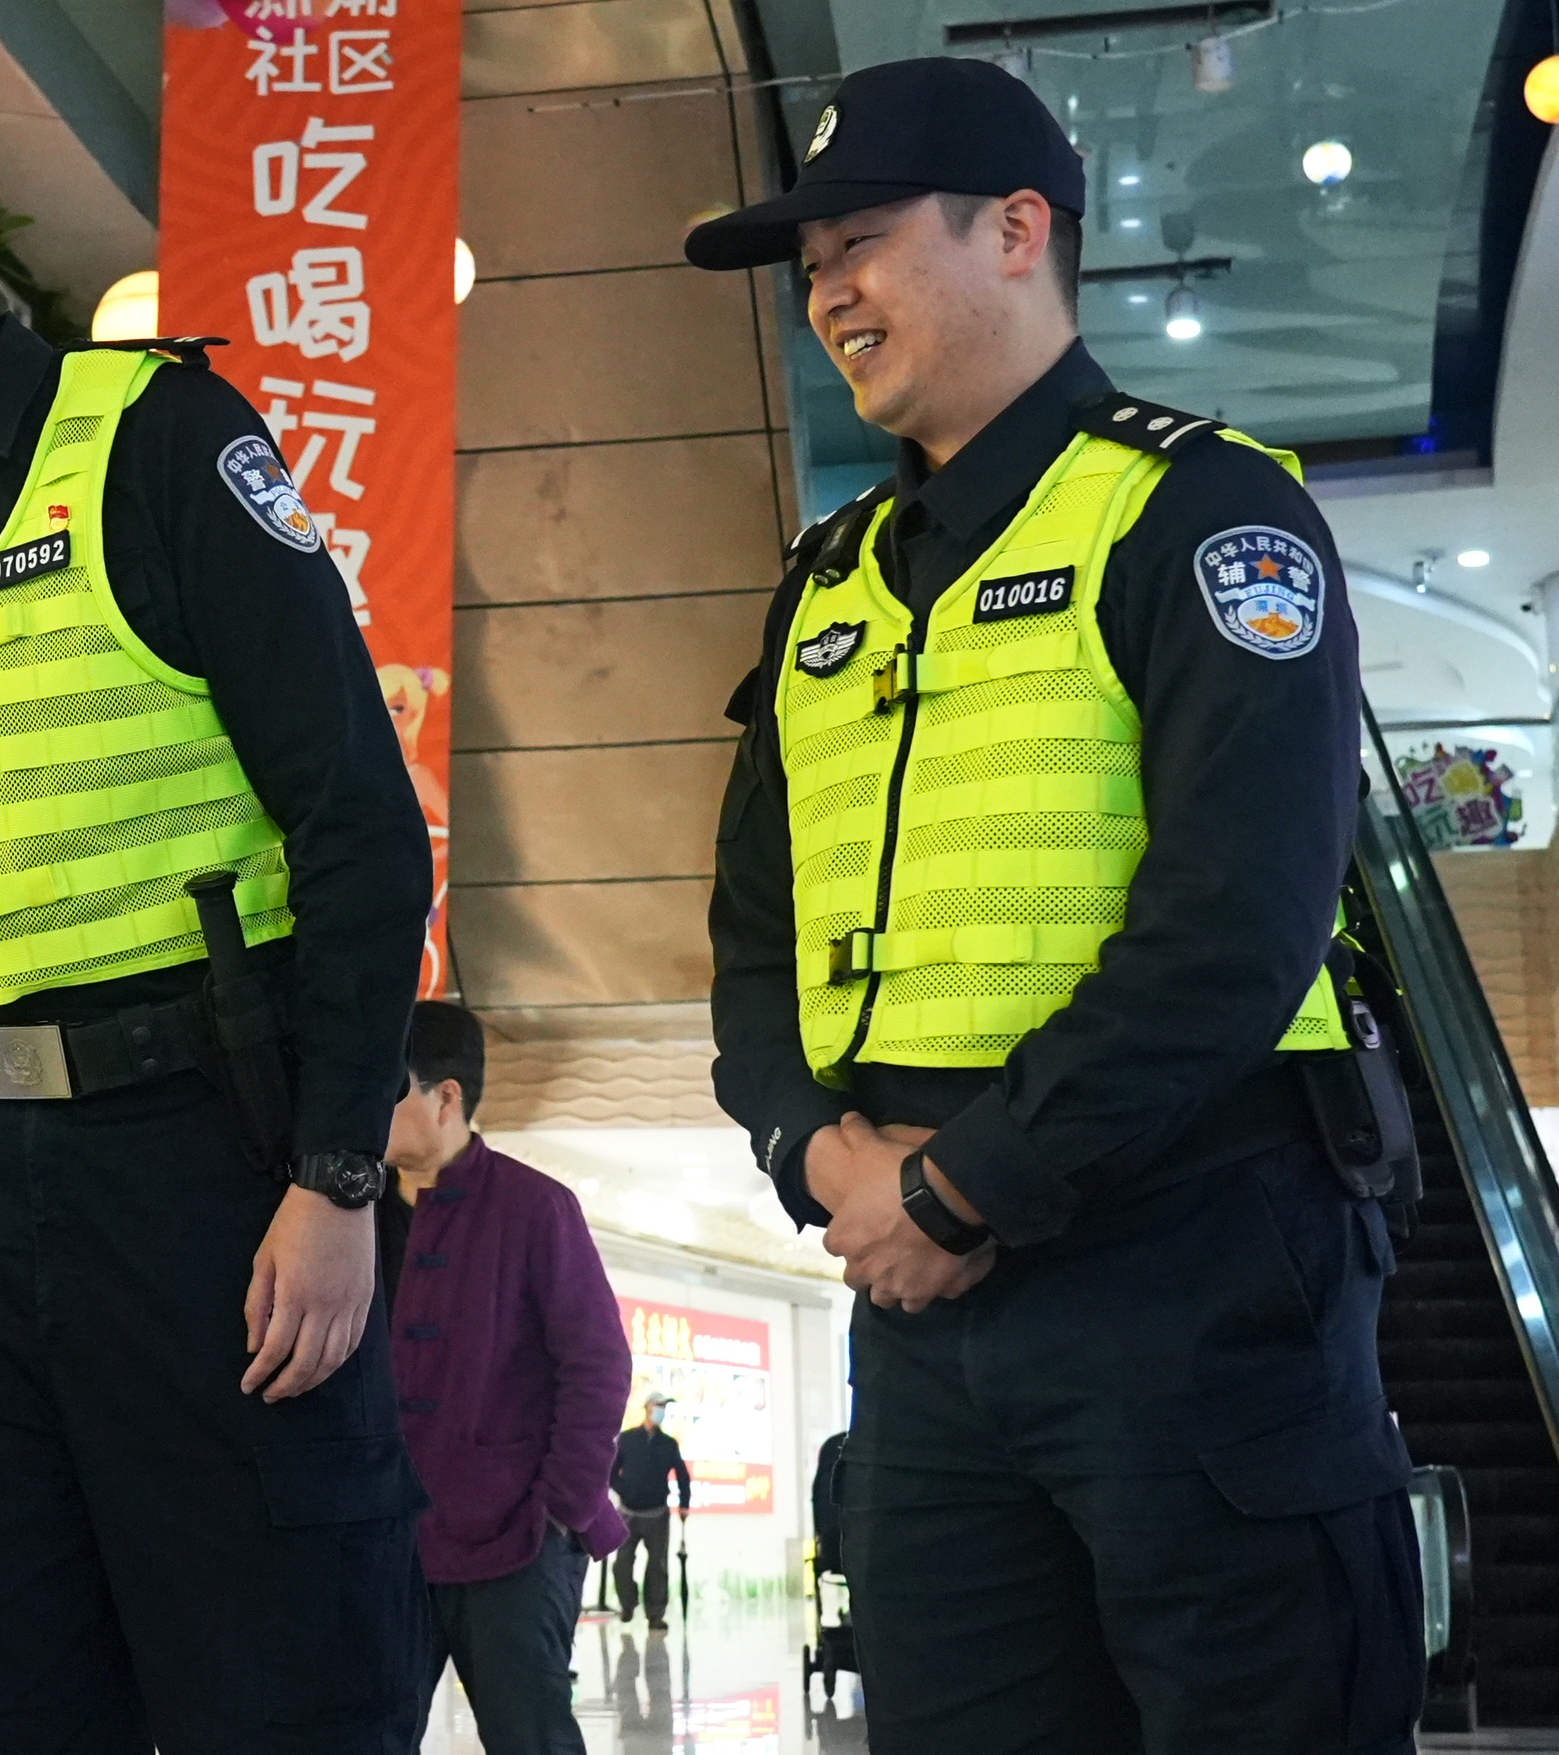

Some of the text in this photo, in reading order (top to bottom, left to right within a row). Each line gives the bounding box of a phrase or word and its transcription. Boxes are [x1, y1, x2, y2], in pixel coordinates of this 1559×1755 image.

[245, 25, 394, 97] 社区
[246, 117, 378, 627] 吃喝玩
[1205, 536, 1315, 576] 中华人民共和国
[979, 577, 1066, 613] 010016
[1244, 584, 1296, 602] FUJING
